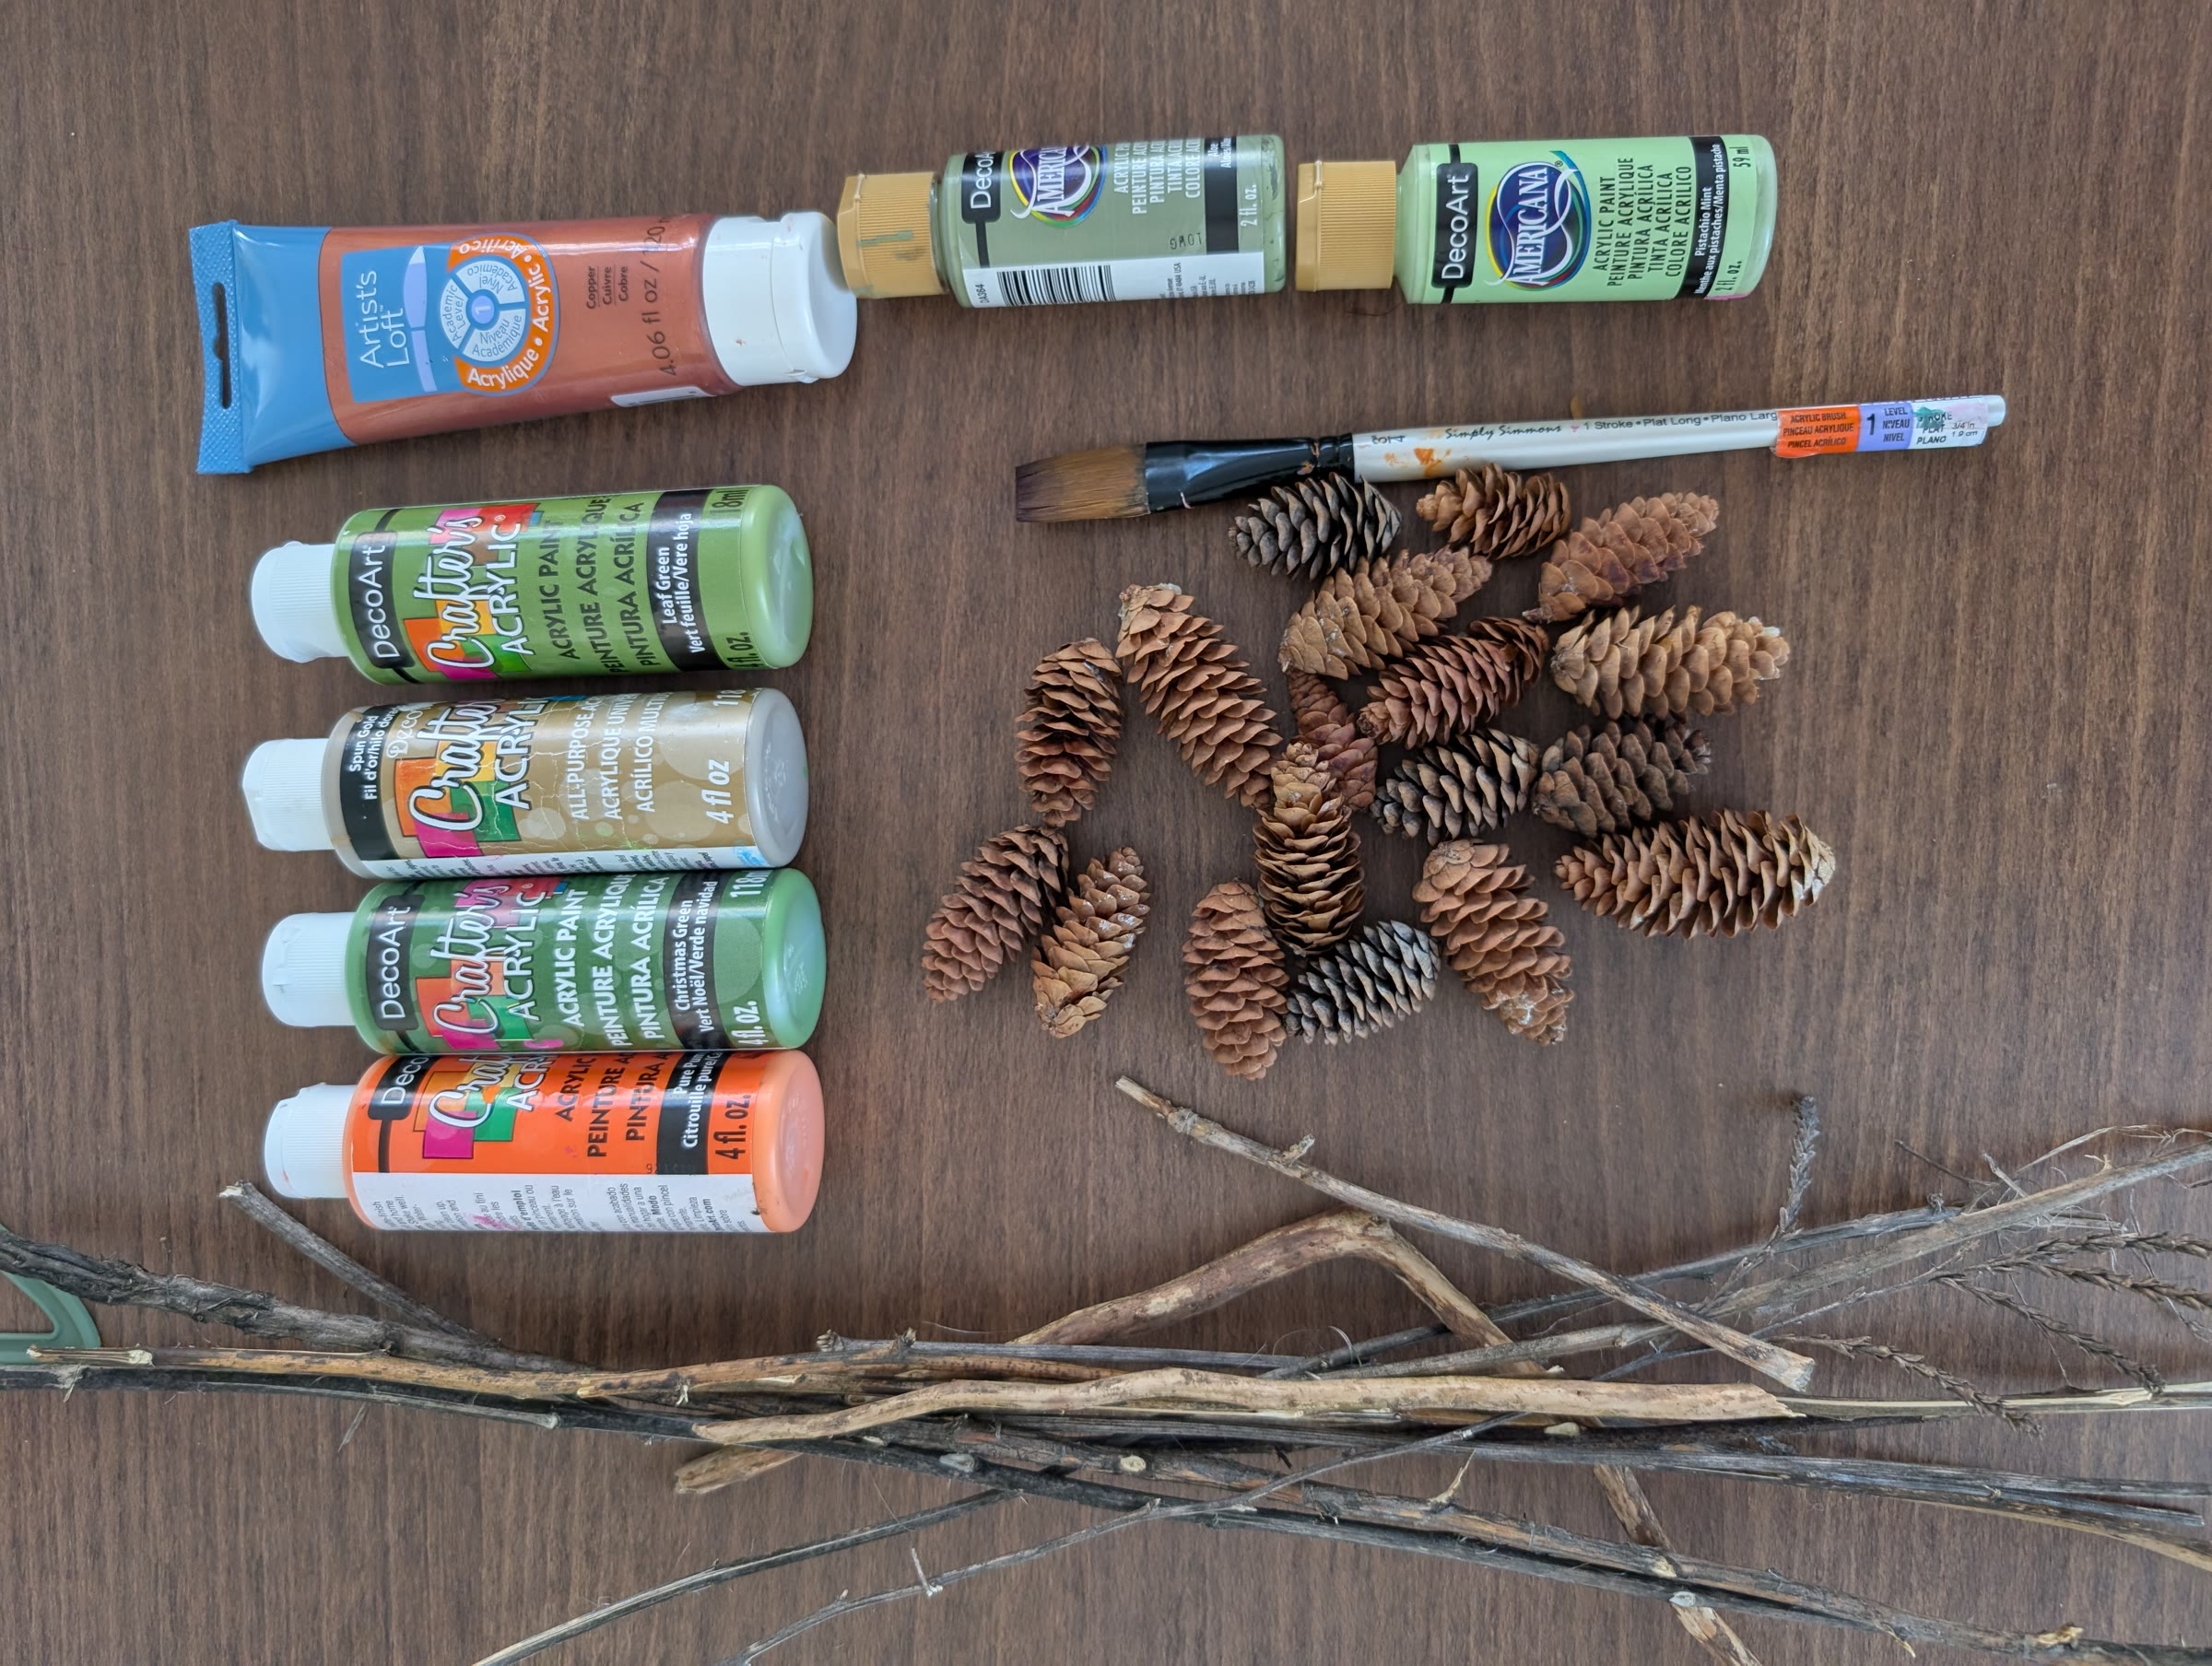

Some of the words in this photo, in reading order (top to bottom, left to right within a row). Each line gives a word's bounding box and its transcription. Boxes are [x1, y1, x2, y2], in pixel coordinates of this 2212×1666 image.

[1113, 152, 1130, 194] ACRYLIC
[1710, 143, 1727, 175] pistacho
[1729, 146, 1749, 156] ml
[1733, 156, 1752, 169] 59
[1131, 158, 1148, 215] PEINTURE
[1148, 155, 1166, 204] PINTURA
[1167, 159, 1183, 194] TINTA
[1184, 155, 1201, 199] COLORE
[1244, 183, 1258, 201] oz.
[1598, 176, 1616, 214] PAINT
[1618, 158, 1634, 227] ACRYLIQUE
[1634, 164, 1654, 223] ACRÍLICA
[1674, 166, 1692, 226] ACRILICO
[1652, 172, 1673, 233] ACRÍLICA
[1700, 186, 1712, 212] Mint
[1707, 174, 1726, 254] pistaches/Menta
[1441, 174, 1471, 280] DecoArt
[1504, 167, 1551, 287] AMERICANA
[1593, 219, 1615, 271] ACRYLIC
[1694, 212, 1712, 257] Pistachio
[1173, 263, 1182, 274] USA
[1606, 232, 1632, 287] PEINTURE
[1627, 229, 1652, 280] PINTURA
[1647, 238, 1669, 273] TINTA
[1665, 231, 1689, 277] COLORE
[1705, 252, 1718, 270] aux
[1725, 260, 1743, 275] oz.
[466, 263, 519, 293] Académico
[585, 265, 597, 310] Copper
[602, 266, 614, 306] Cuivre
[618, 265, 629, 302] Cobre
[644, 277, 658, 304] oz
[1694, 269, 1712, 295] Menthe
[356, 270, 385, 370] Artist's
[442, 284, 463, 343] Academic
[453, 294, 467, 331] Level
[466, 346, 540, 390] Acrylique
[526, 263, 552, 334] Acrylic
[473, 304, 492, 316] 1
[478, 317, 512, 346] Niveau
[641, 311, 662, 324] fl
[381, 307, 411, 368] Loft
[471, 313, 523, 358] Académique
[646, 331, 677, 377] 4.06
[1444, 426, 1495, 441] Simply
[1498, 424, 1562, 437] Simmons
[1594, 420, 1634, 430] Stroke
[1642, 417, 1668, 428] Plat
[1670, 416, 1701, 427] Long
[1710, 413, 1747, 423] Plano
[1749, 411, 1778, 421] Larg
[1783, 425, 1813, 436] PINCEAU
[1814, 422, 1854, 434] ACRYLIQUE
[1790, 414, 1820, 424] ACRYLIC
[1821, 411, 1847, 421] BRUSH
[1866, 412, 1876, 436] 1
[1884, 406, 1908, 416] LEVEL
[1951, 422, 1966, 430] 3/4
[1787, 439, 1812, 449] PINCEL
[1812, 436, 1847, 447] ACRÍLICO
[1883, 433, 1905, 442] NIVEL
[1916, 436, 1947, 445] PLANO
[537, 519, 564, 578] PAINT
[574, 496, 612, 597] ACRYLQUE
[671, 512, 694, 541] hoja
[485, 522, 536, 656] ACRYLIC
[655, 546, 672, 591] Green
[673, 543, 698, 628] feuille/Vere
[358, 545, 401, 659] DecoArt
[412, 516, 505, 669] Crafter's
[655, 591, 677, 625] Leaf
[539, 580, 581, 661] ACRYLIC
[579, 601, 629, 673] PEINTURE
[617, 590, 662, 667] PINTURA
[680, 628, 706, 653] Vert
[725, 631, 754, 651] oz.
[350, 740, 367, 773] Spun
[361, 715, 380, 739] Gold
[365, 731, 385, 781] d'or/hilo
[566, 711, 594, 820] ALL-PURPOSE
[364, 784, 378, 801] Fil
[600, 728, 624, 820] ACRYLIQUE
[630, 734, 656, 813] ACRÍLICO
[707, 759, 731, 786] oz
[702, 788, 732, 806] fl
[705, 811, 734, 825] 4
[557, 888, 589, 942] PAINT
[629, 876, 671, 951] ACRÍLICA
[672, 899, 694, 938] Green
[695, 880, 718, 924] navidad
[378, 905, 411, 1019] DecoArt
[429, 885, 509, 1034] Crafter's
[502, 890, 547, 1022] ACRYLIC
[673, 941, 692, 1012] Christmas
[688, 927, 709, 1006] Noël/Verde
[554, 943, 585, 1027] ACRYLIC
[593, 965, 634, 1047] PEINTURE
[630, 956, 666, 1039] PINTURA
[696, 1008, 715, 1033] Vert
[733, 1000, 761, 1025] oz.
[380, 1056, 430, 1105] Deco
[625, 1062, 665, 1142] PINTURA
[672, 1069, 696, 1095] Pure
[586, 1067, 627, 1158] PEINTURE
[682, 1084, 708, 1149] Citrouille
[724, 1094, 751, 1120] oz.
[712, 1124, 747, 1144] fl.
[714, 1148, 746, 1160] 4
[562, 1188, 573, 1196] le
[606, 1187, 622, 1214] acabado
[634, 1186, 645, 1200] una
[648, 1195, 663, 1216] Modo
